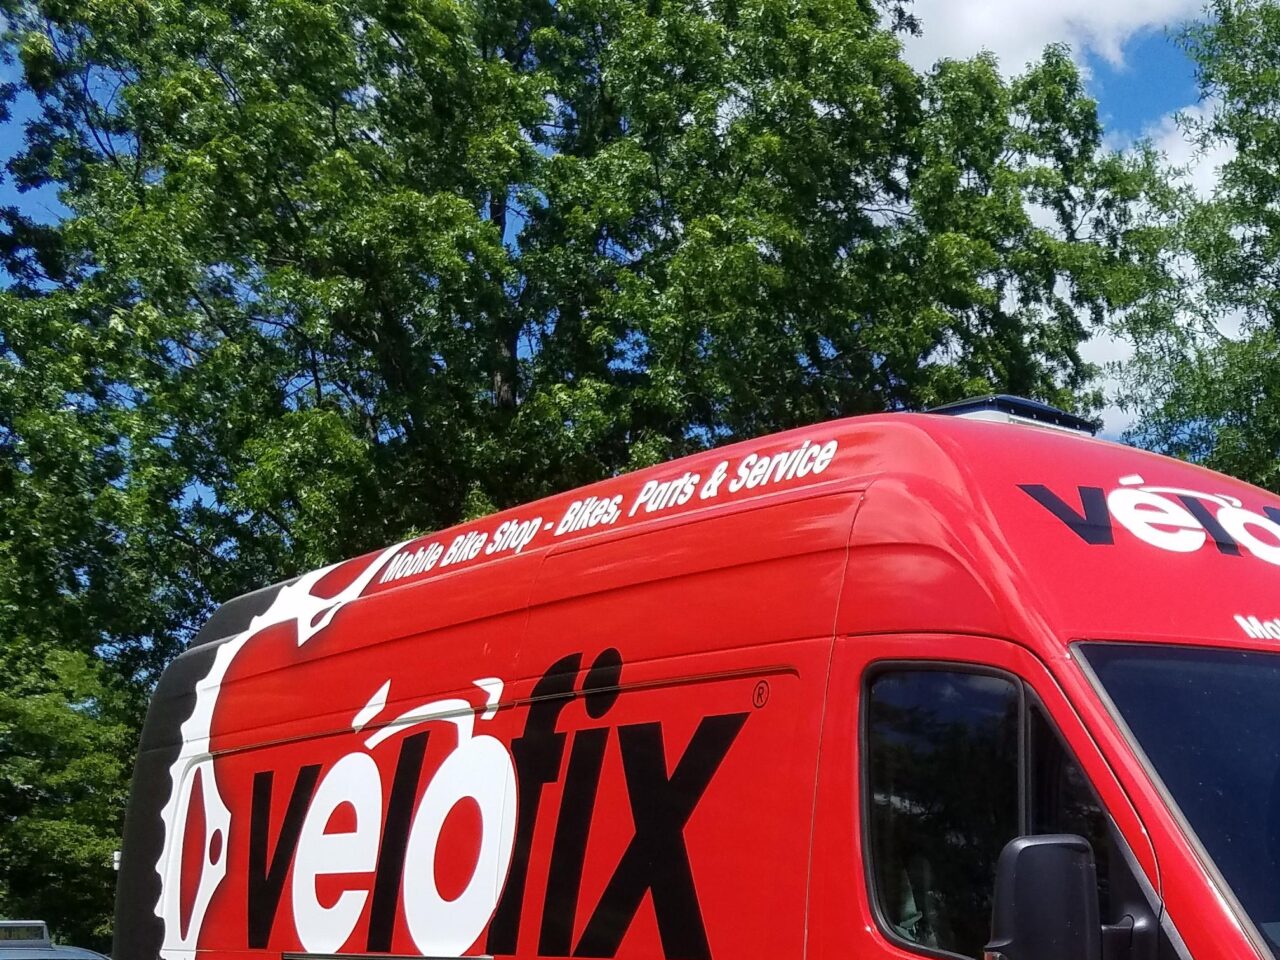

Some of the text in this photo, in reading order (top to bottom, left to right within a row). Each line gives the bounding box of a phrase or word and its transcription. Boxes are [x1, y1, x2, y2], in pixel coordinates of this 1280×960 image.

[379, 542, 444, 584] Mobile
[440, 531, 488, 567] Bike
[485, 517, 542, 554] Shop
[554, 496, 622, 536] Bikes,
[628, 471, 700, 517] Parts
[700, 460, 729, 500] &
[728, 439, 838, 493] Service
